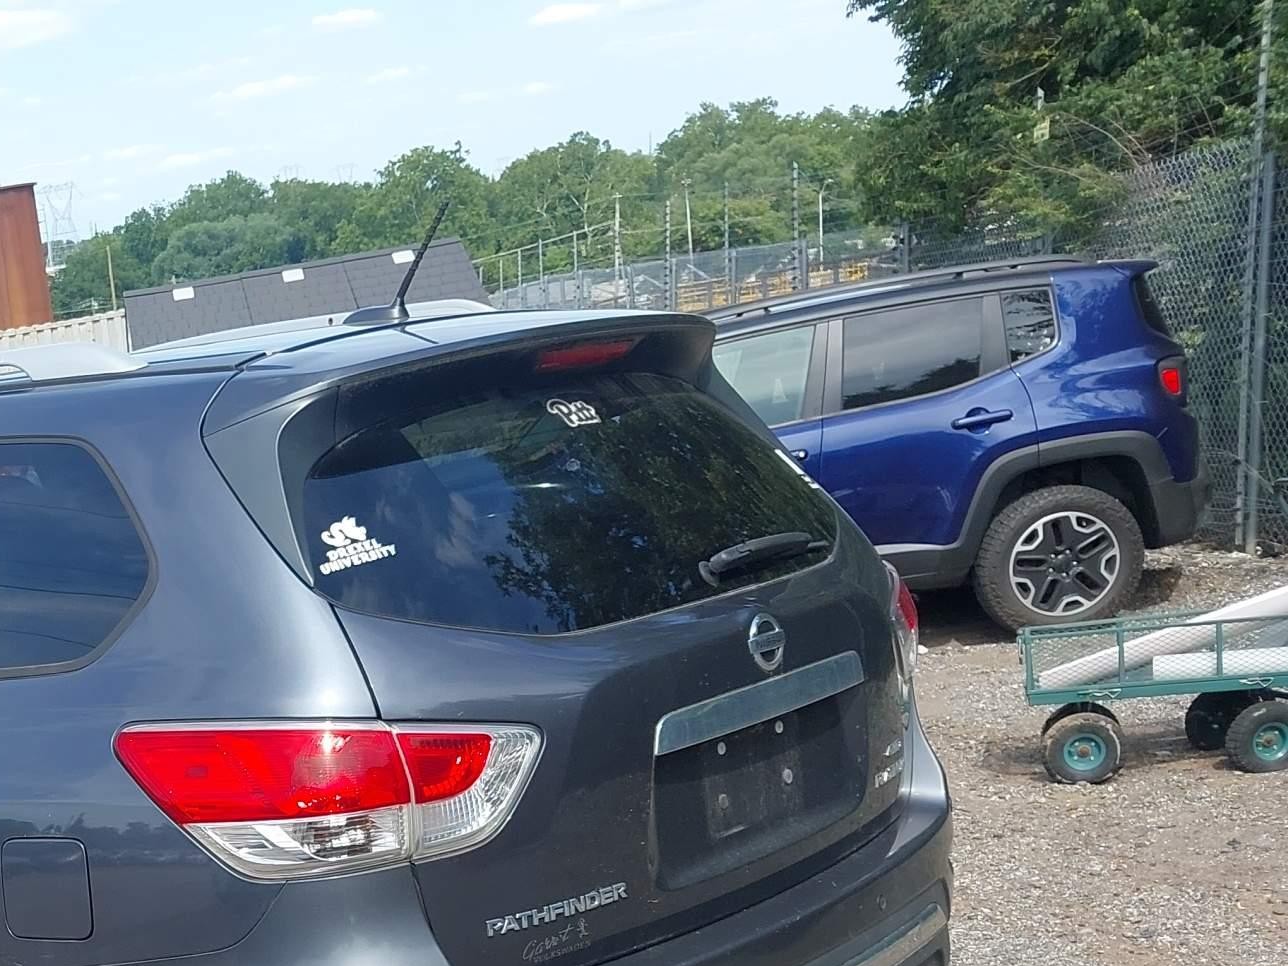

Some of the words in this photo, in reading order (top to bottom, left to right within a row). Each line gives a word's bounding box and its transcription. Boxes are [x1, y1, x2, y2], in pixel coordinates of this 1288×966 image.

[319, 544, 396, 575] UNIVERSITY
[326, 537, 382, 561] DREXEL
[485, 882, 628, 937] PATHFINDER
